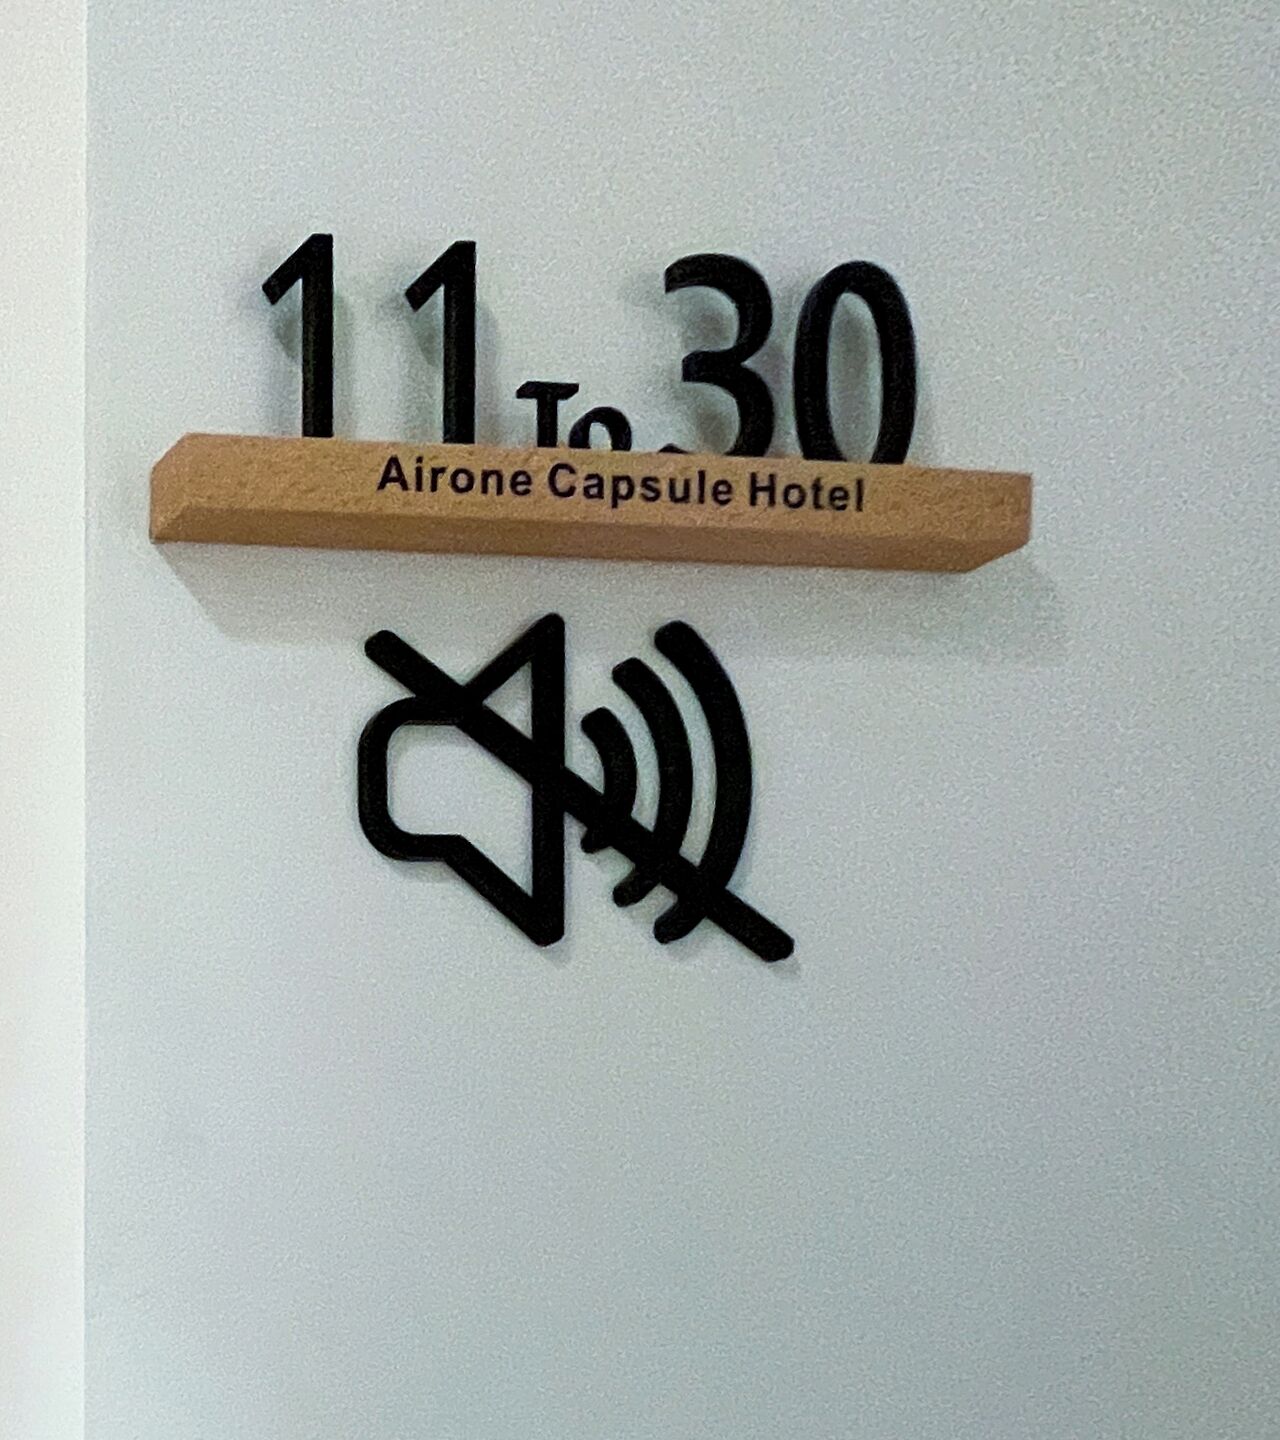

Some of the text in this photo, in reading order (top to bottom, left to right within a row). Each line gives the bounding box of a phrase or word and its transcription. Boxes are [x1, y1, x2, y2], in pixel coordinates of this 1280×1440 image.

[262, 233, 918, 464] 11 To 30
[377, 455, 865, 512] Airone Capsule Hotel
